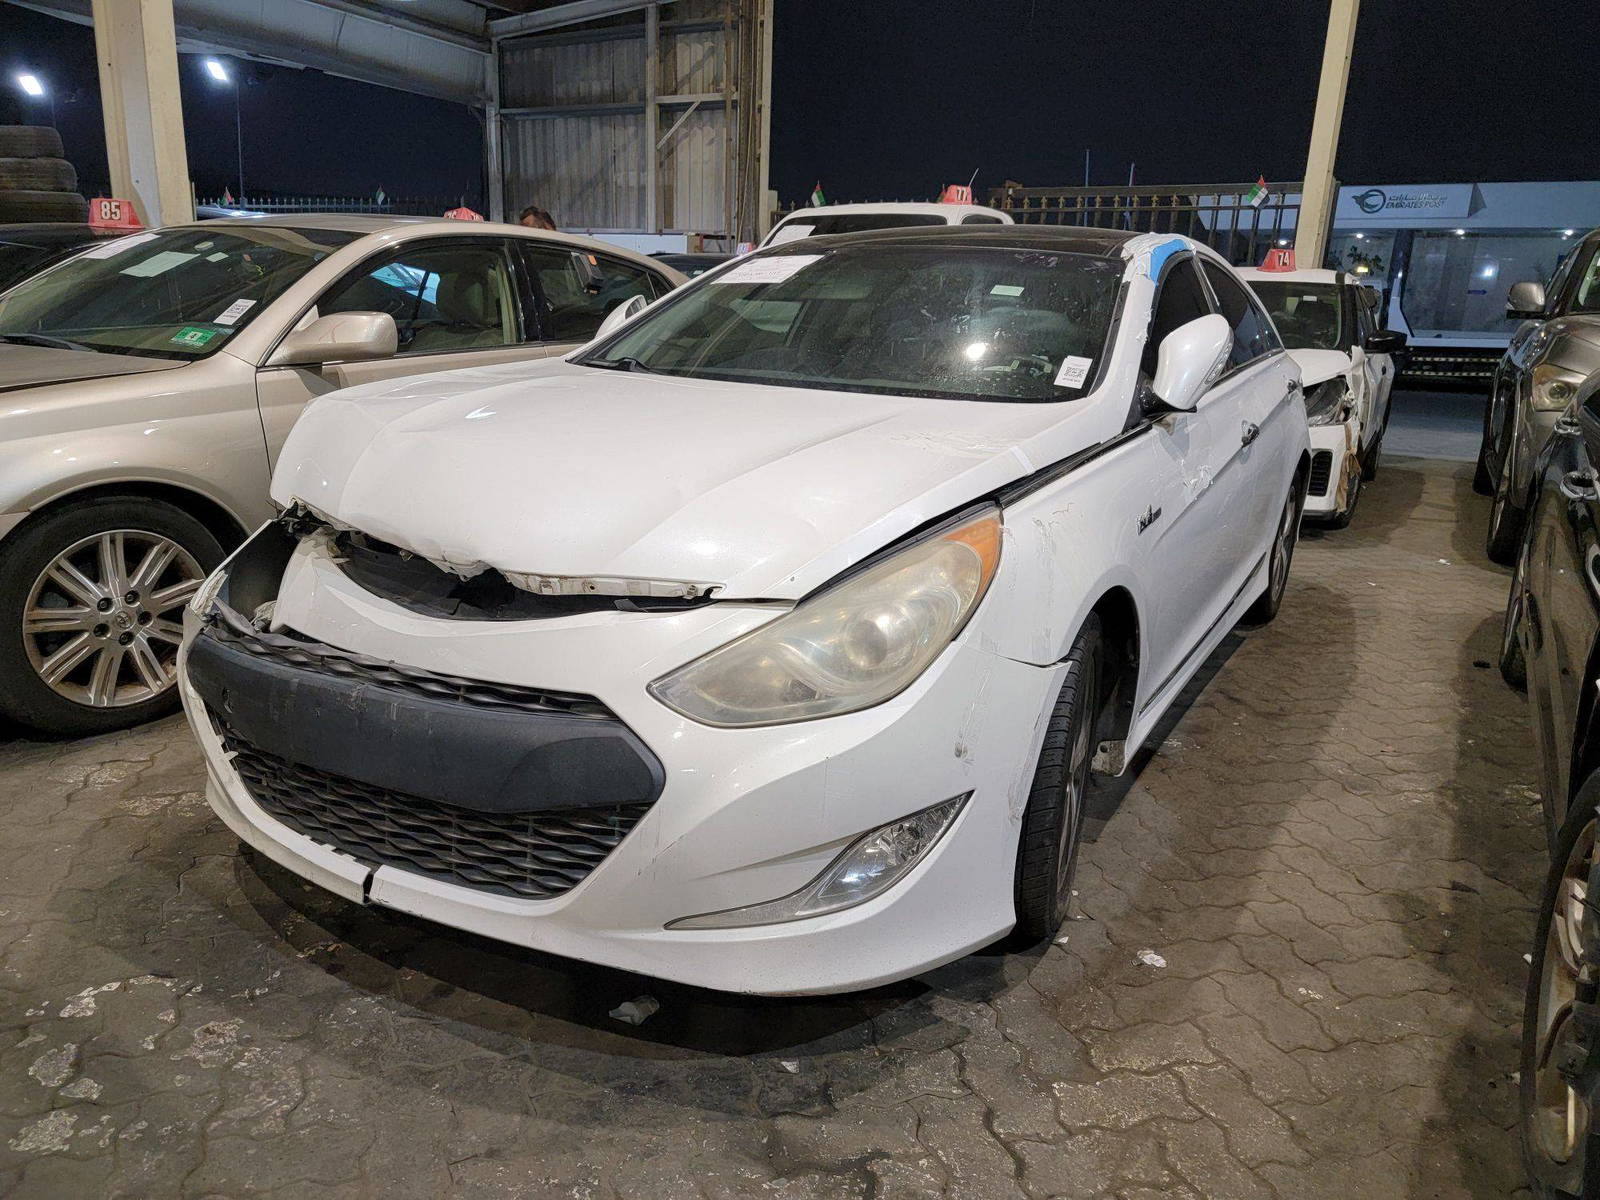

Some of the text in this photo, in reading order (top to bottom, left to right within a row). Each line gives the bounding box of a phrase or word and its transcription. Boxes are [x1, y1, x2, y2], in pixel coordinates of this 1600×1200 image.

[101, 200, 121, 220] 85
[1385, 200, 1422, 209] EMIRATES
[1278, 251, 1290, 267] 74
